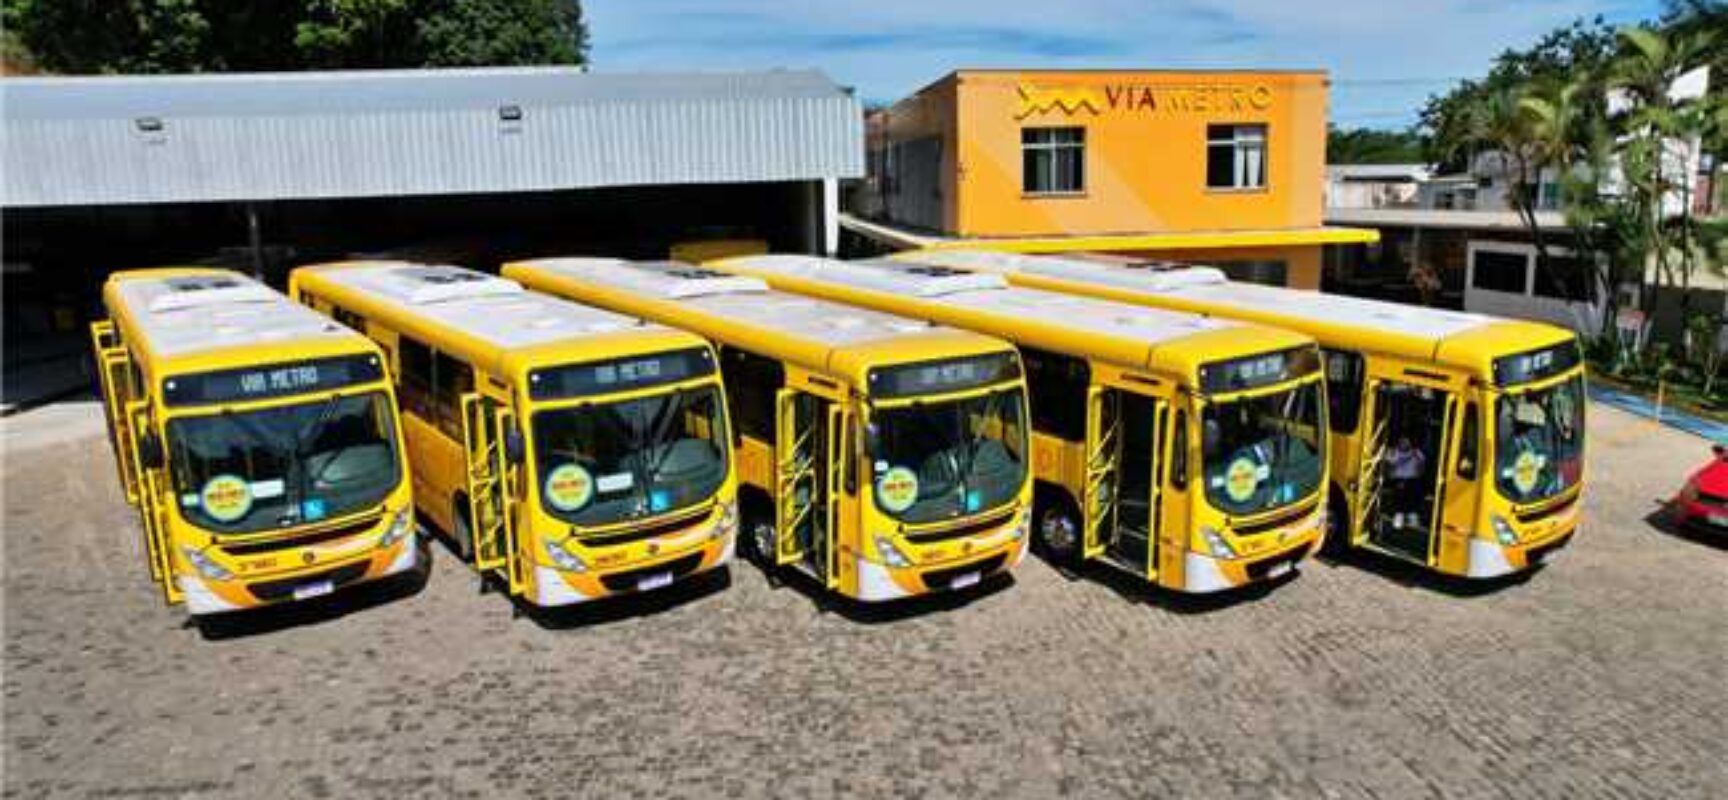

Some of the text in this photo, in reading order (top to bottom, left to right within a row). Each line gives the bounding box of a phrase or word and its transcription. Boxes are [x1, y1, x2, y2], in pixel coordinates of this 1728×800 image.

[1104, 85, 1270, 111] VIA METRO
[241, 366, 318, 392] VIA METRO
